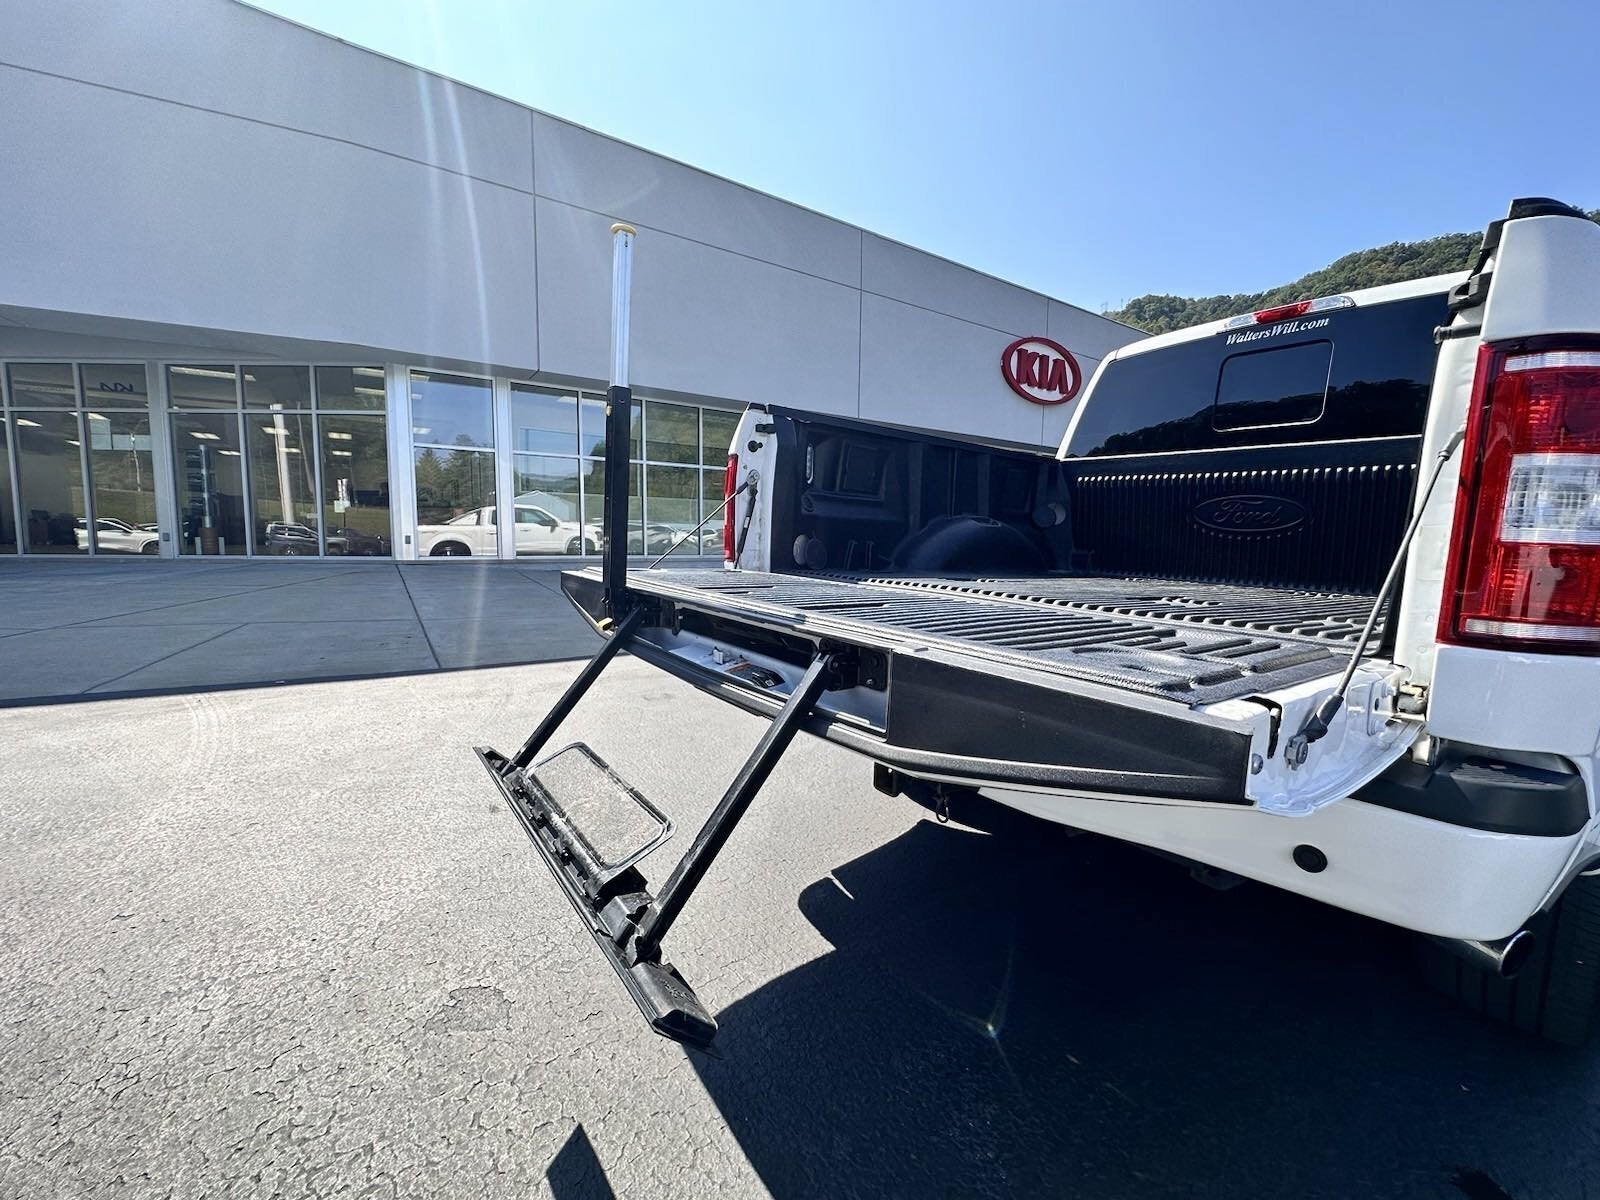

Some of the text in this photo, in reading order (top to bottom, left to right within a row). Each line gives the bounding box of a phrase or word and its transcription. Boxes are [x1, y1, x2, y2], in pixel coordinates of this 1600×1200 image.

[1226, 318, 1330, 345] WaltersWill.com
[1016, 348, 1069, 395] KIA
[1213, 500, 1283, 524] Ford
